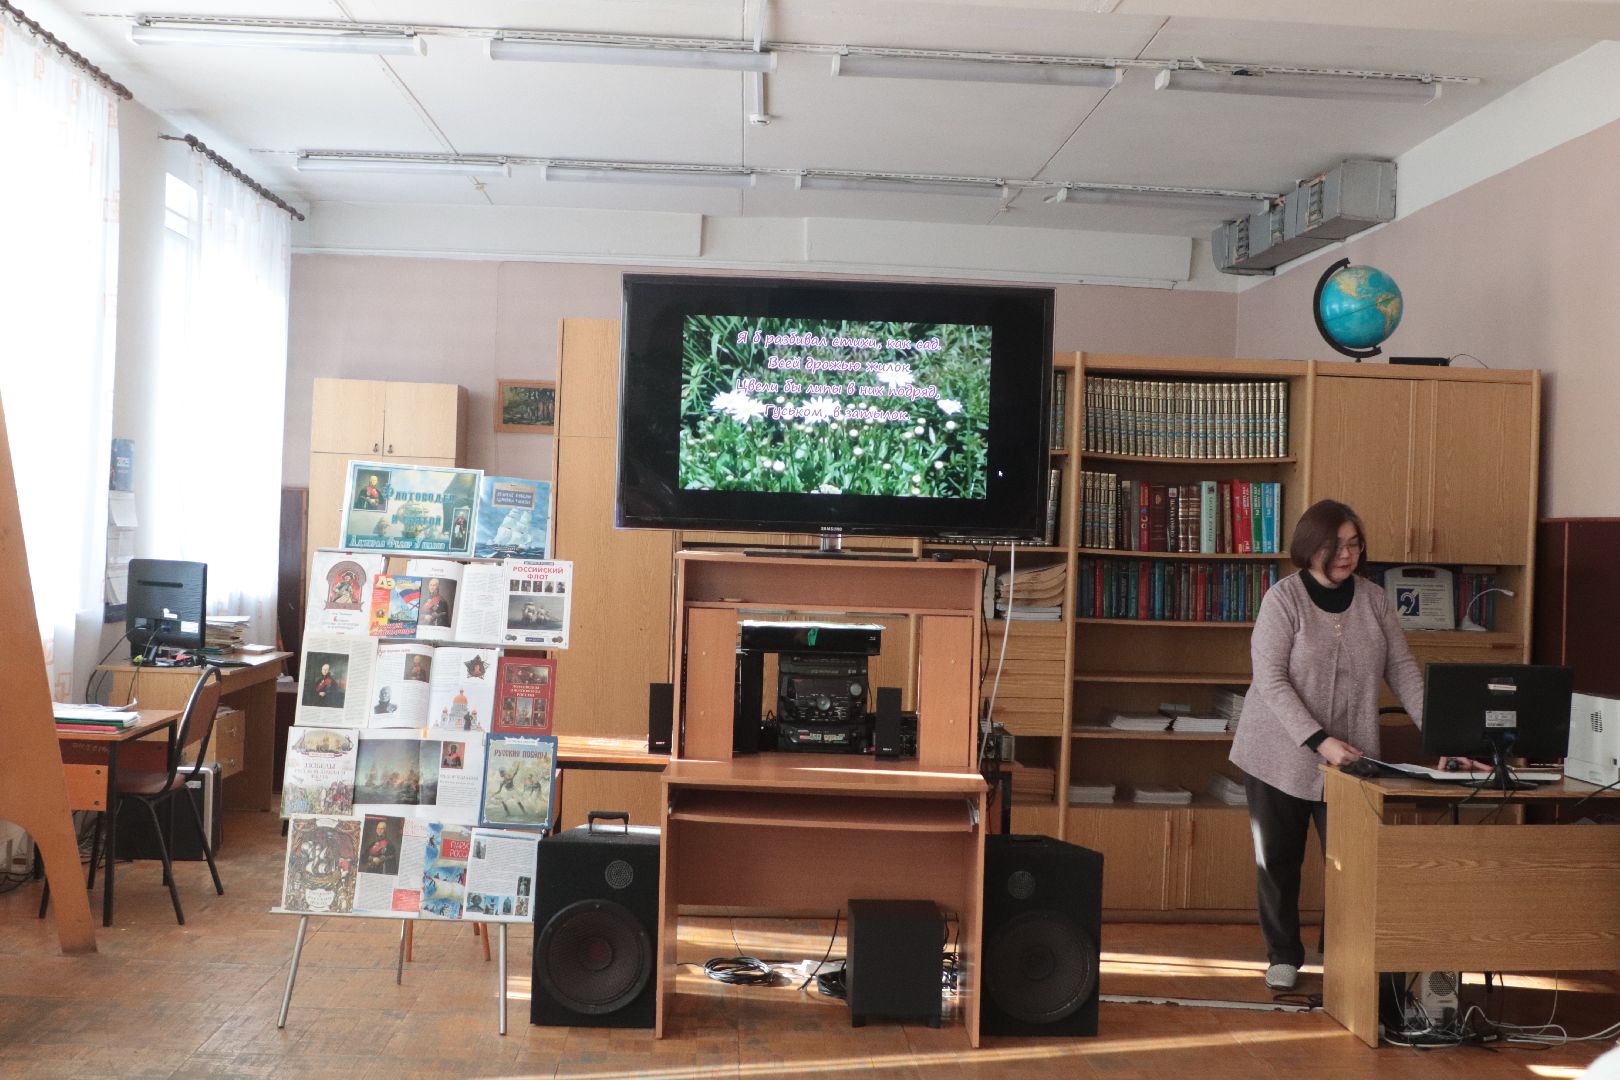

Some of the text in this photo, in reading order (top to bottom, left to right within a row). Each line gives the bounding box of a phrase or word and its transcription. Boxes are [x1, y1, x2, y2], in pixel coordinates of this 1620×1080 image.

[737, 330, 942, 351] Я б разбивал стихи, как сад.
[767, 355, 801, 370] Всей
[805, 356, 861, 373] дрожью
[736, 378, 941, 401] Цвели бы липы в них подряд,
[764, 403, 911, 421] Гуськом, в затылок.
[512, 565, 564, 575] РОССИЙСКИЙ
[527, 573, 549, 581] ФЛОТ
